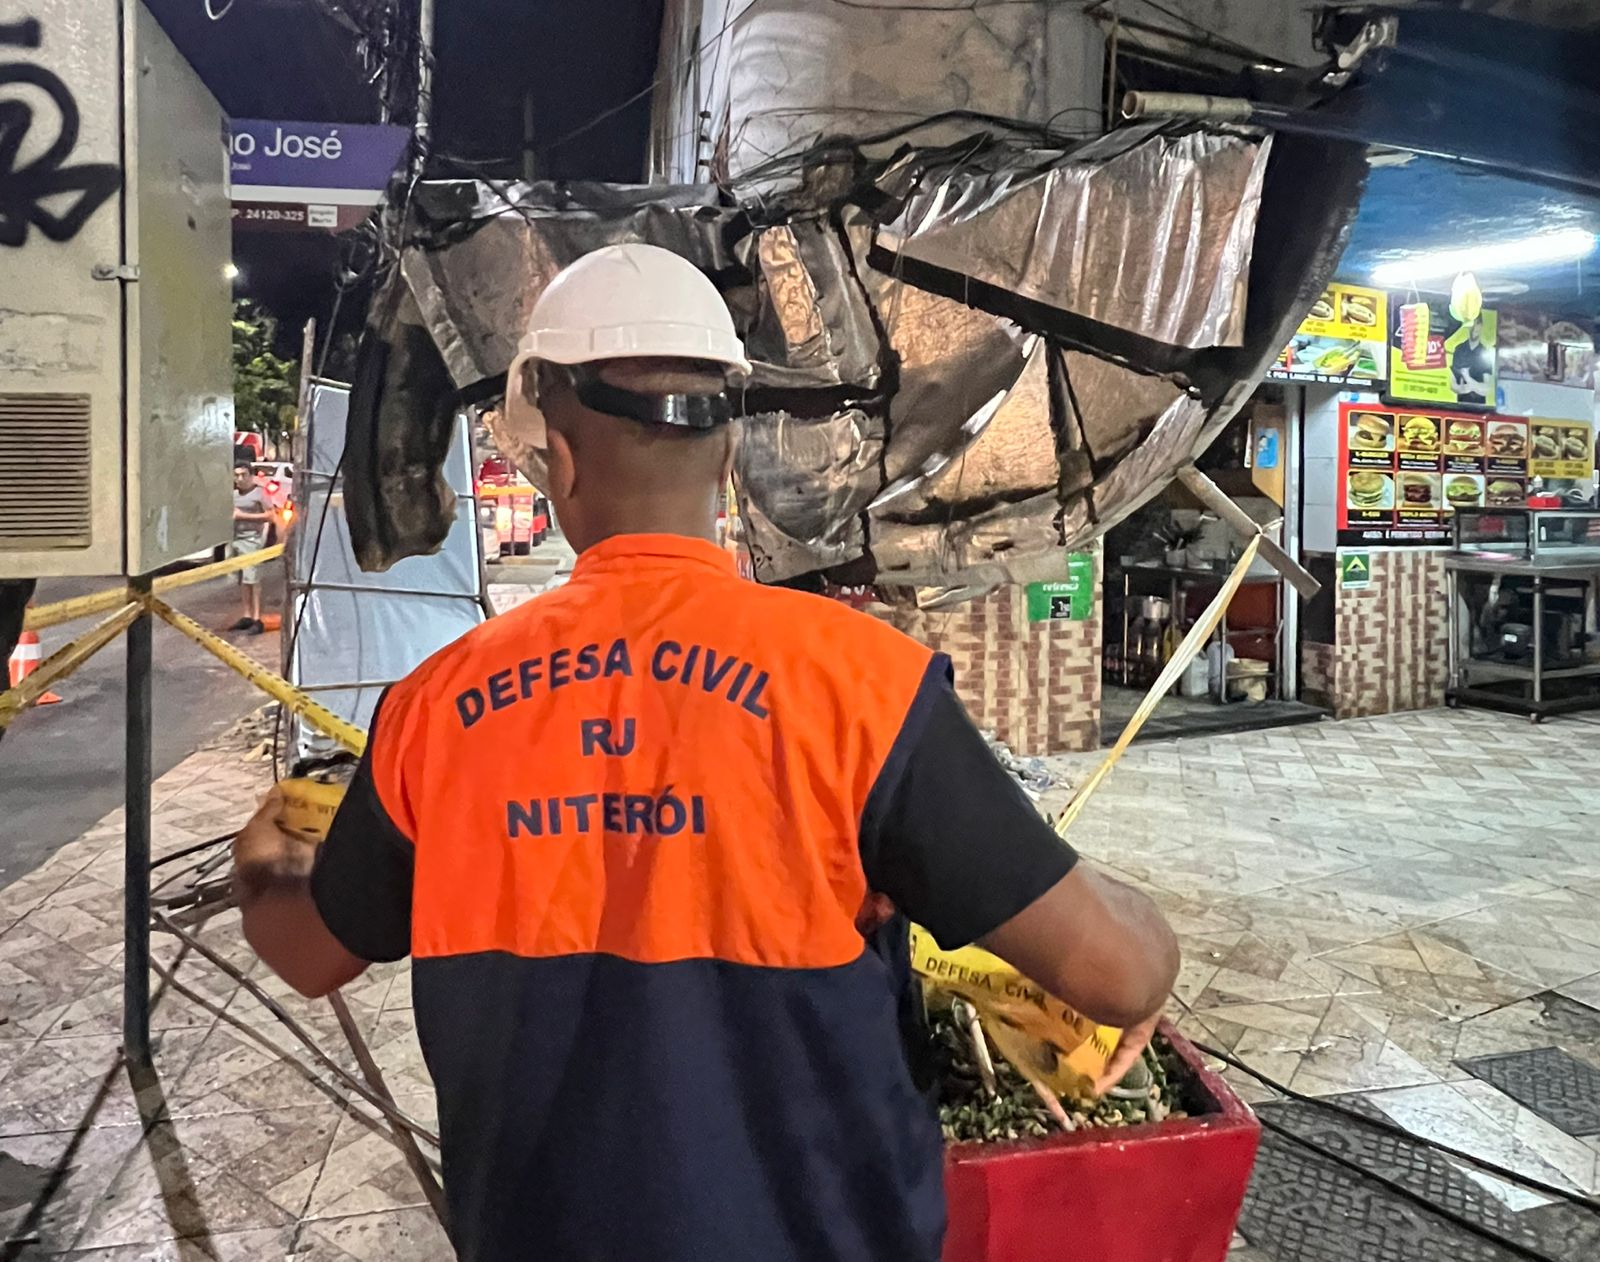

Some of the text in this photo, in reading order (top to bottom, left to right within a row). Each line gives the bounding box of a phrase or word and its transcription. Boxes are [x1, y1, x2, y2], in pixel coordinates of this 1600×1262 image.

[264, 127, 343, 160] José
[455, 637, 770, 730] DEFESA CIVIL
[581, 717, 636, 757] RJ
[506, 784, 706, 839] NITERÓI
[926, 956, 992, 991] DEFESA
